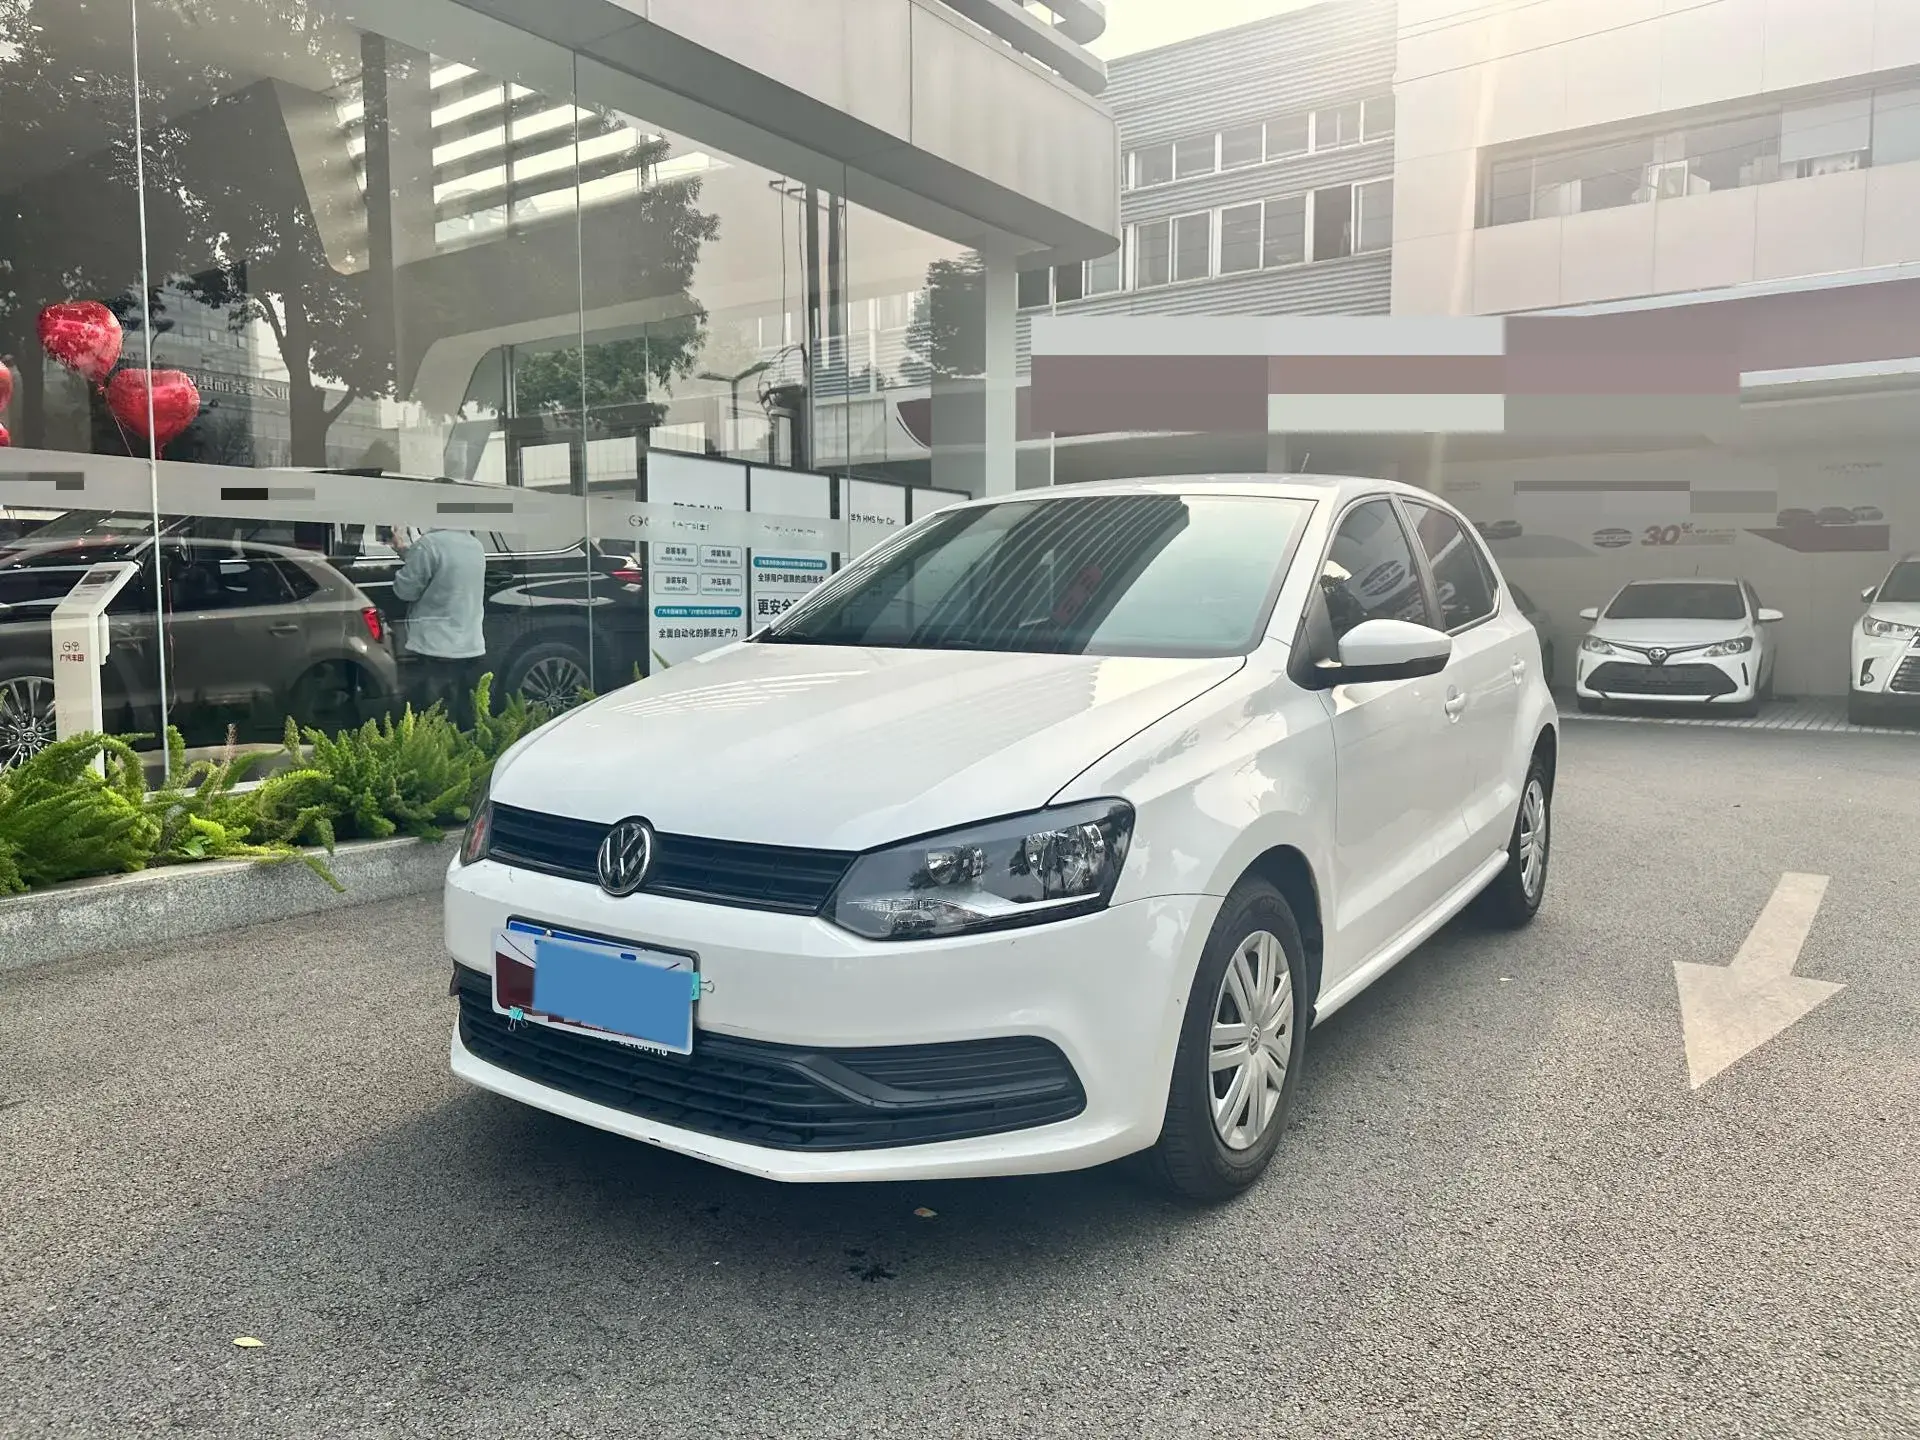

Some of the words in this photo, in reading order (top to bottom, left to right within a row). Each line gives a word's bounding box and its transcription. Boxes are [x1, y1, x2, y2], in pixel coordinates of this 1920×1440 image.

[863, 514, 876, 523] HMS
[659, 628, 738, 638] 全面自动化的新质生产力
